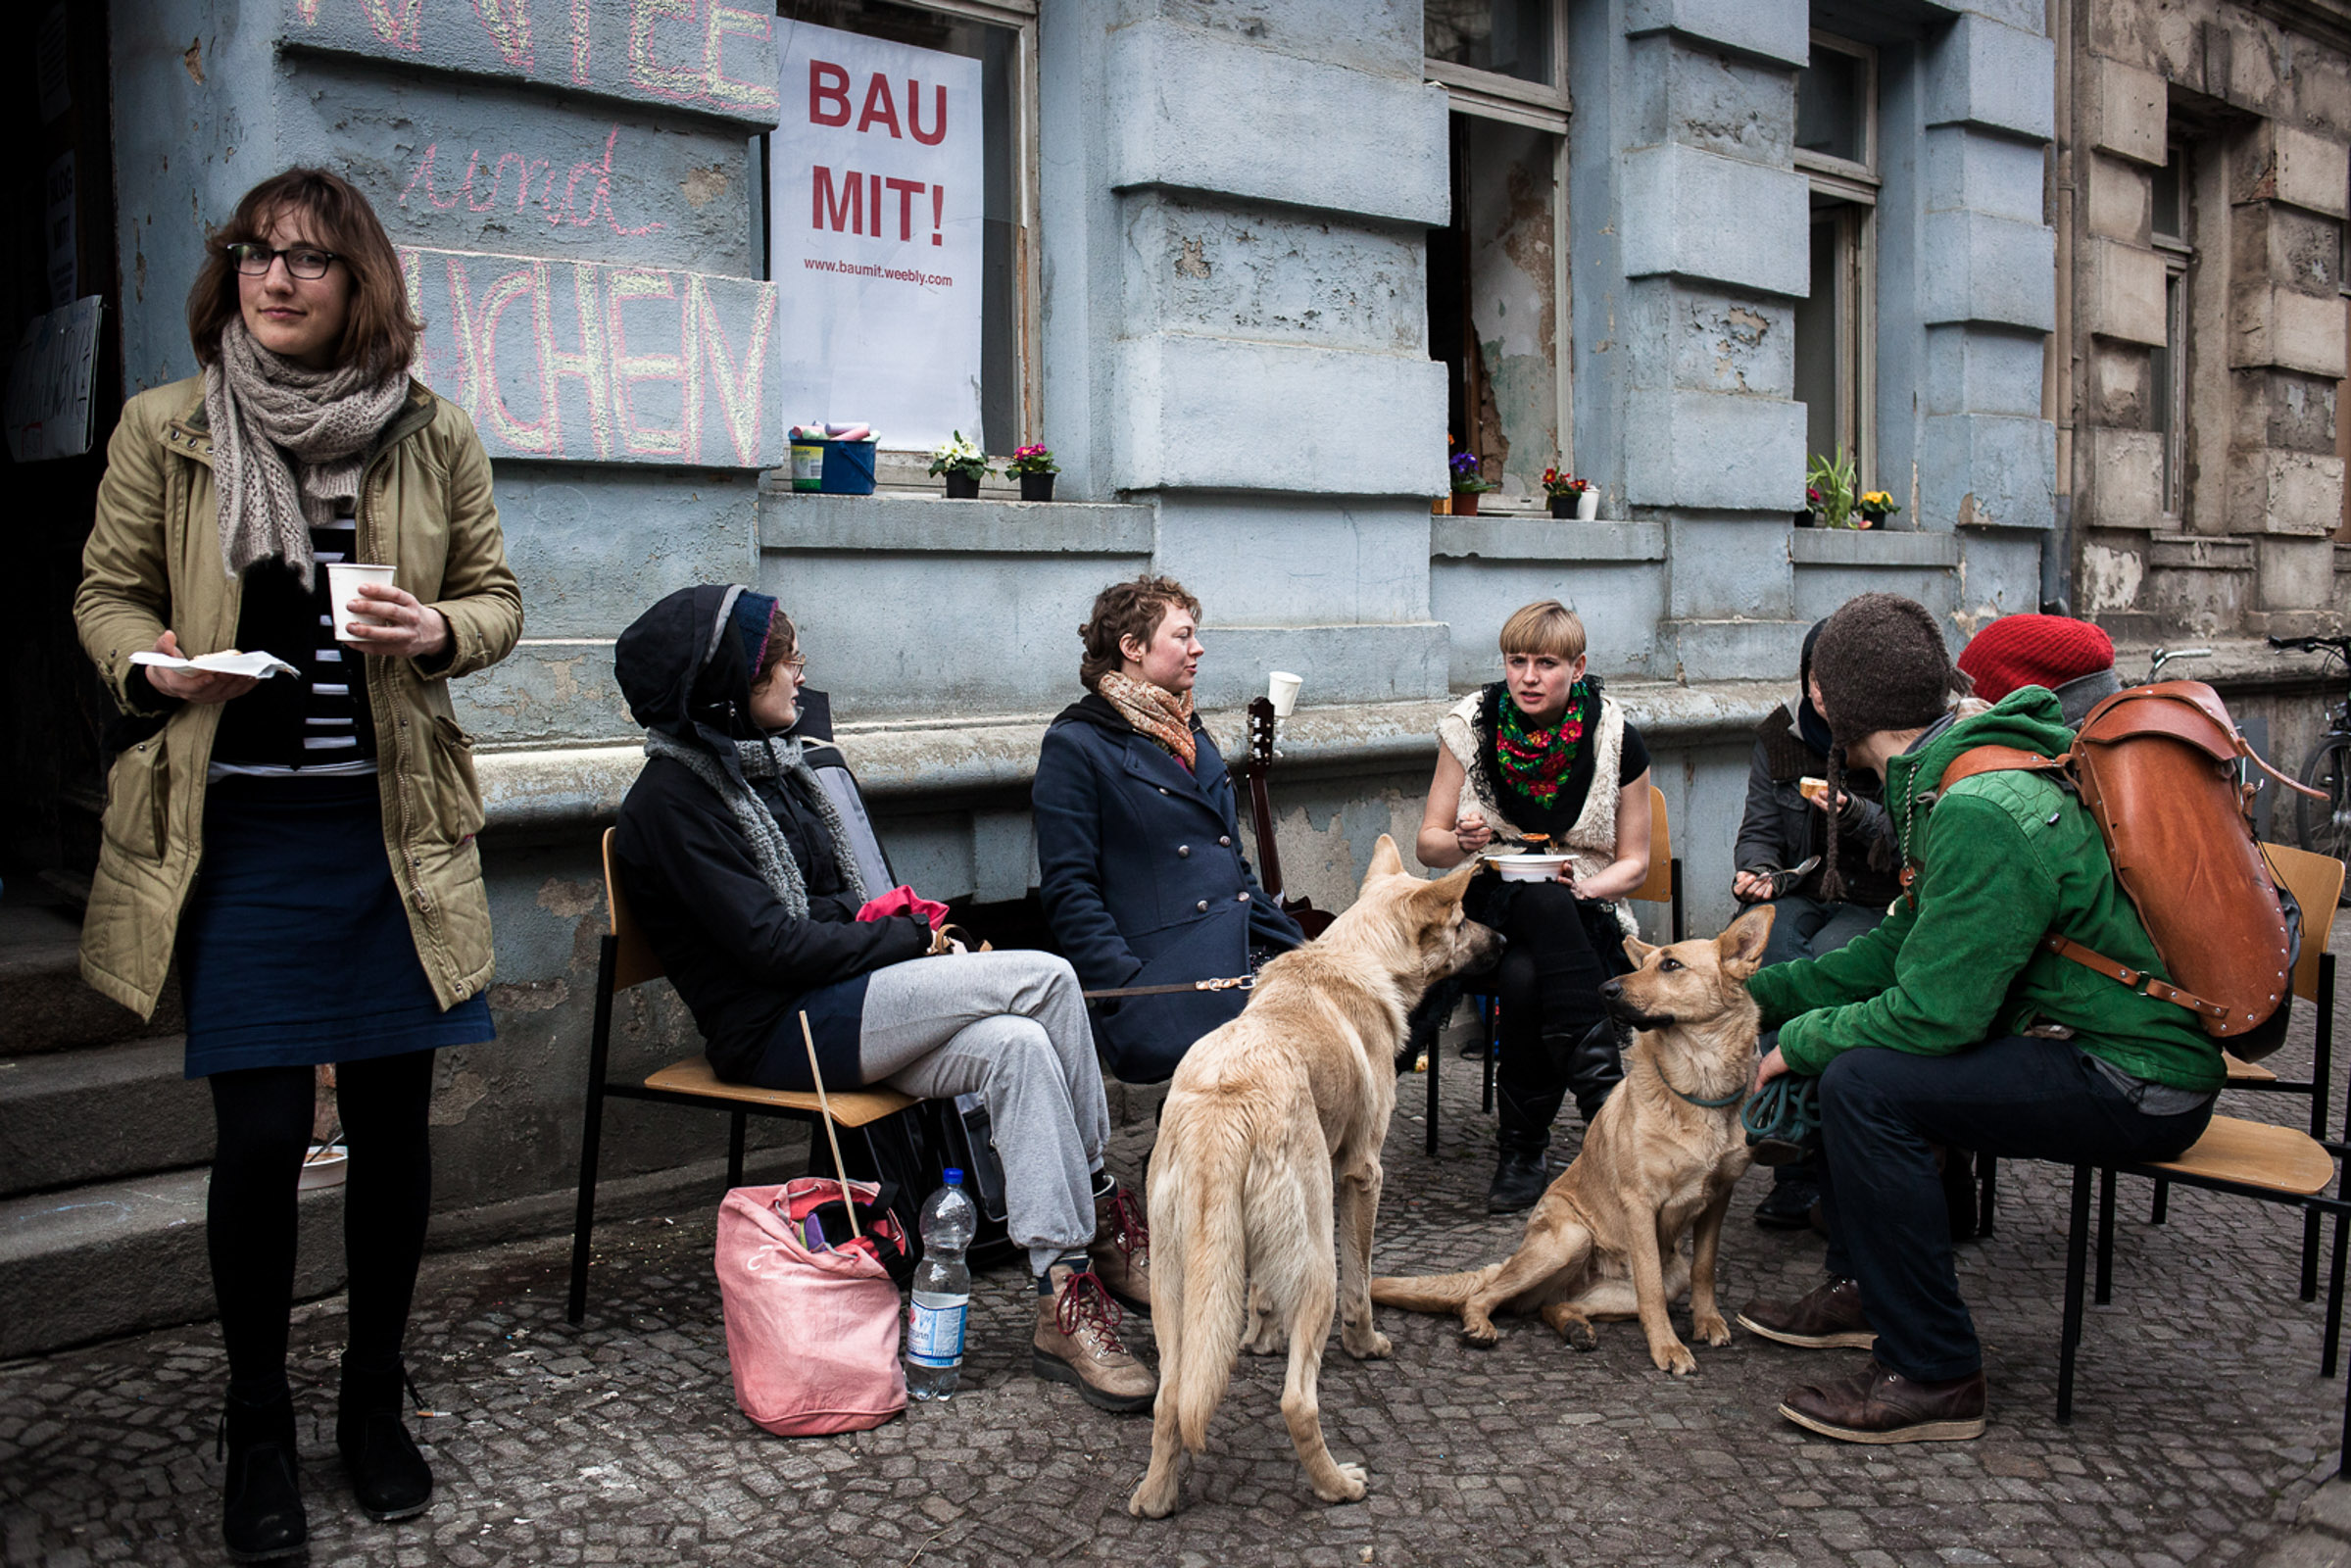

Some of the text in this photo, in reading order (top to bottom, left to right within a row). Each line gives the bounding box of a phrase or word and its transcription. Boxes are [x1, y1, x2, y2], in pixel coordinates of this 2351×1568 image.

[809, 59, 947, 146] BAU
[398, 122, 667, 236] und
[812, 165, 944, 246] MIT!
[804, 257, 954, 287] www.baumit.weebly.com
[400, 249, 779, 467] UCHEN
